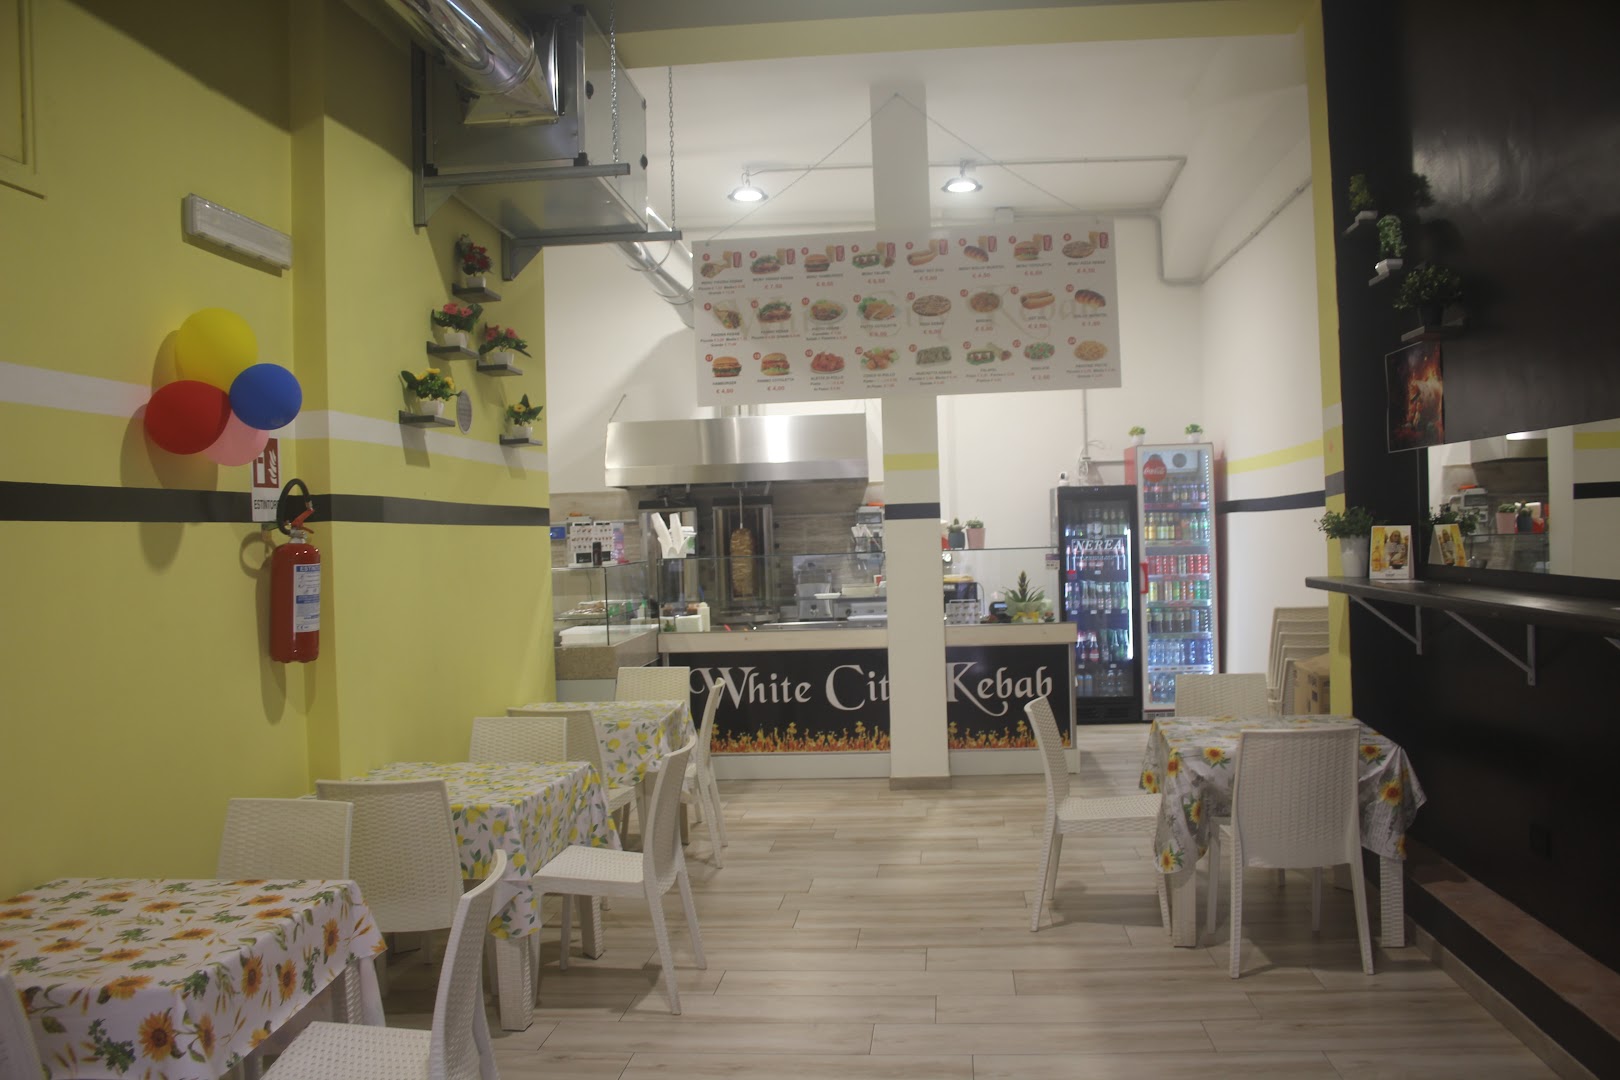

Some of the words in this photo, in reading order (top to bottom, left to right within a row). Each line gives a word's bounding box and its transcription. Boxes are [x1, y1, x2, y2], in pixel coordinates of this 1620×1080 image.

[254, 499, 279, 510] ESTINTOR
[690, 666, 812, 710] White
[825, 664, 889, 711] Cit
[946, 661, 1053, 717] Kebab
